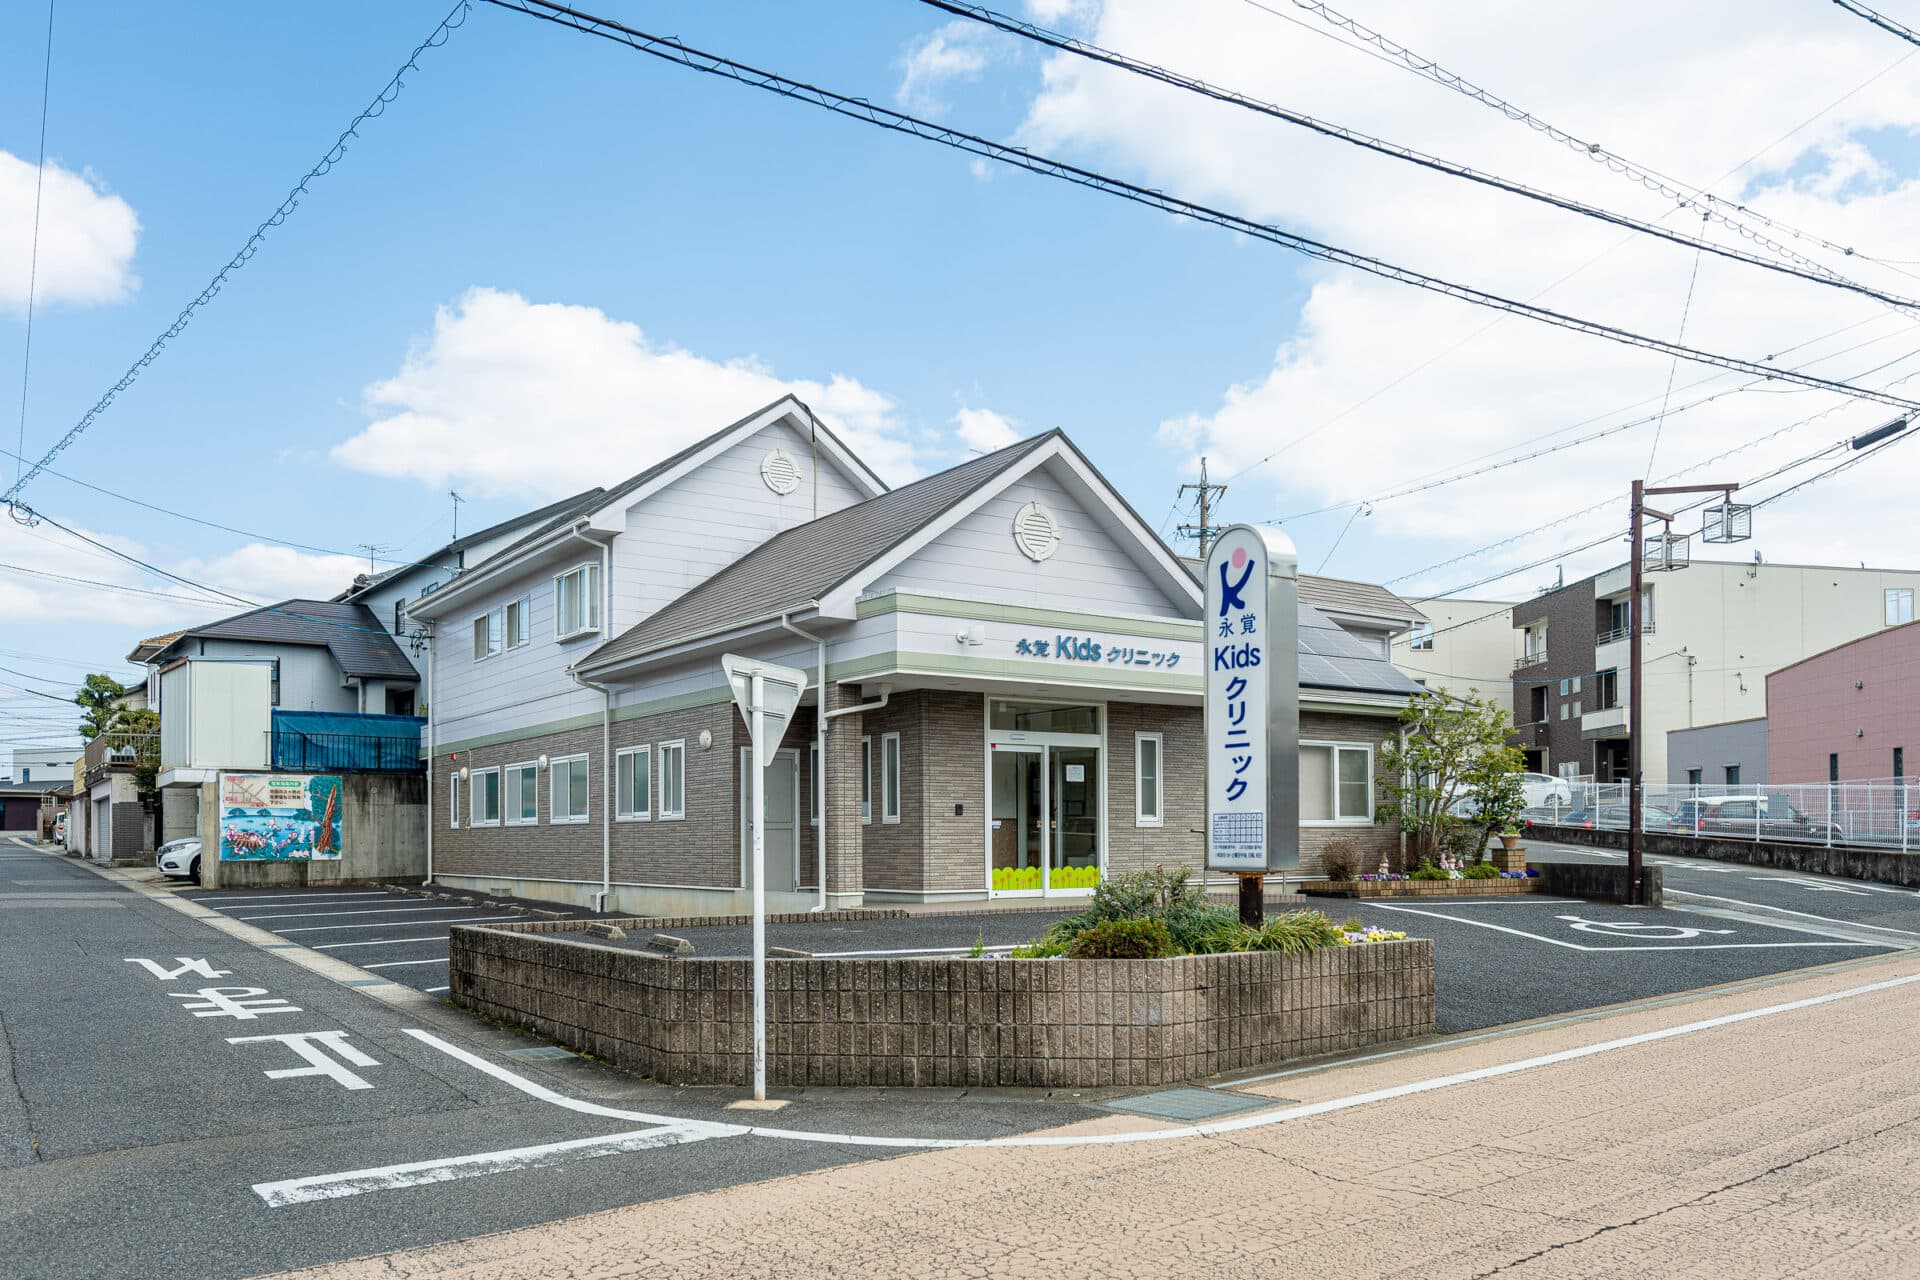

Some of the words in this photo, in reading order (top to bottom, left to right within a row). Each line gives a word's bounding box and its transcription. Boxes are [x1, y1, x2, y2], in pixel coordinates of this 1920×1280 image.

[1219, 613, 1256, 638] 永覚
[1015, 637, 1050, 657] 永覚
[1056, 635, 1102, 661] Kids
[1107, 646, 1181, 667] クリニック
[1214, 642, 1261, 672] Kids
[1225, 676, 1252, 801] クリニック
[123, 957, 383, 1090] 止まれ
